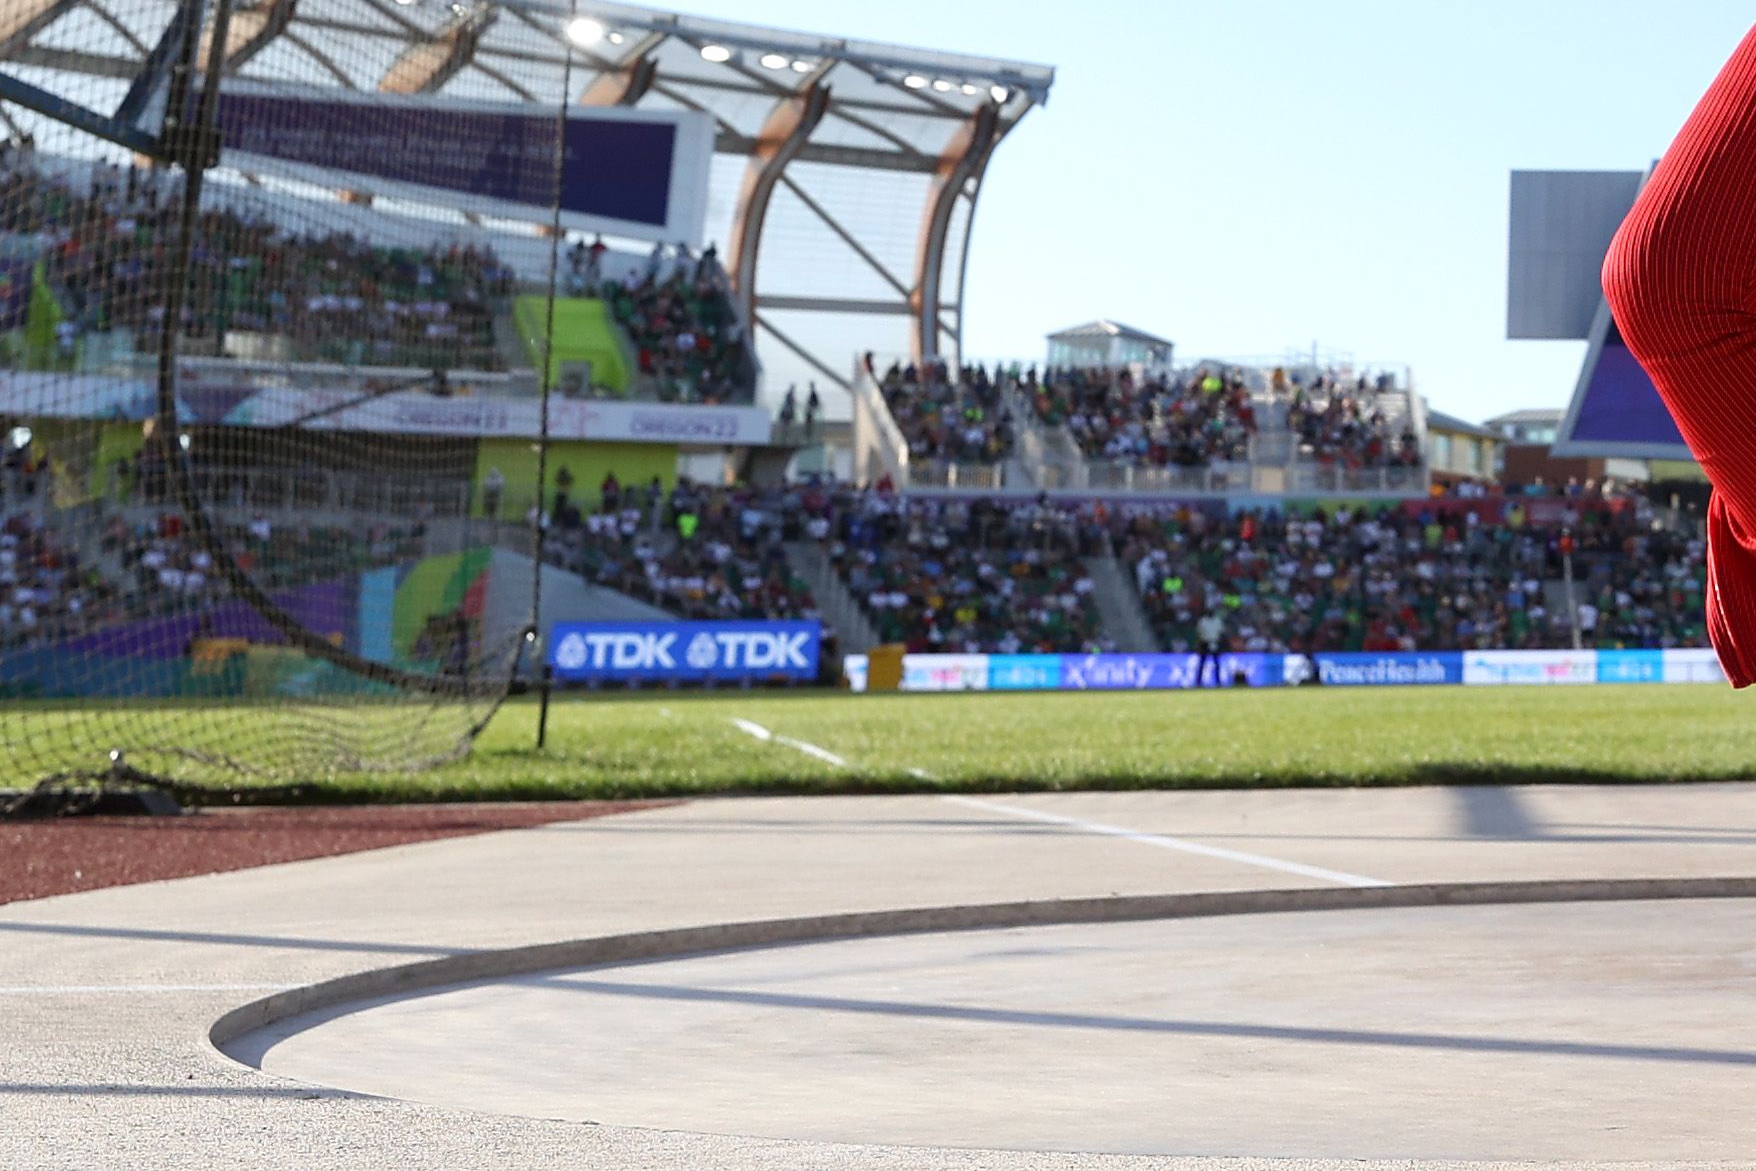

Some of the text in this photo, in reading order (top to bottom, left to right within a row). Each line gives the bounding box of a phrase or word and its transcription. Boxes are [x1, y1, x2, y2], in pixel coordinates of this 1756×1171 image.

[586, 632, 810, 668] TDK TDK
[1066, 655, 1154, 690] xfinity
